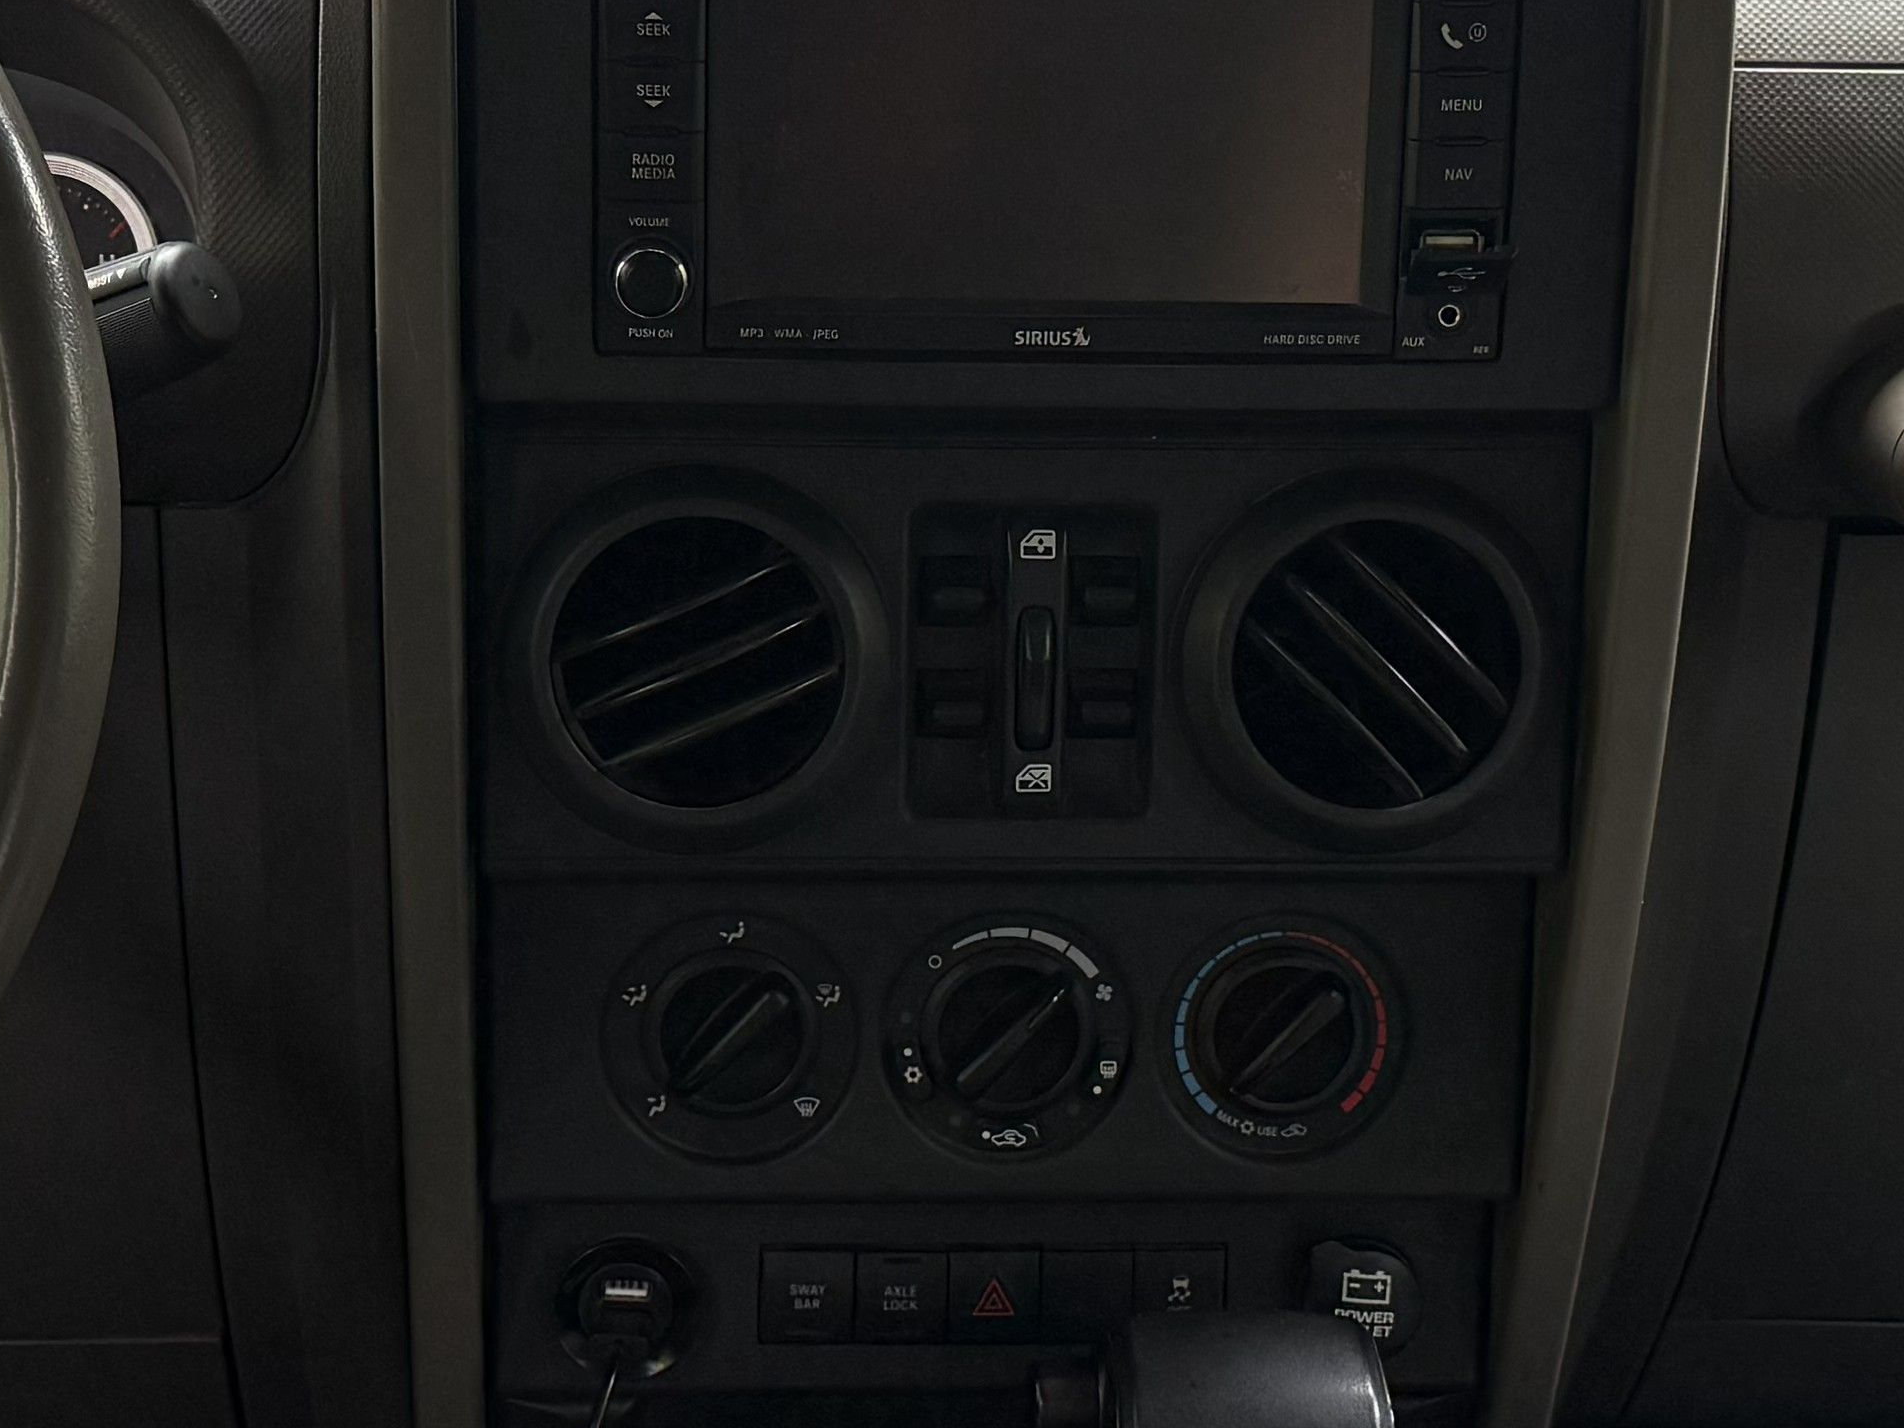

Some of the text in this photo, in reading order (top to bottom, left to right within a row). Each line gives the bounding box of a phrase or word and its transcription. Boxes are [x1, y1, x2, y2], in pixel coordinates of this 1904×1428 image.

[636, 23, 672, 36] SEEK
[636, 83, 672, 97] SEEK
[1440, 98, 1483, 112] MENU
[631, 153, 675, 166] RADIO
[631, 167, 676, 180] MEDIA
[1444, 168, 1474, 181] NAV
[628, 216, 671, 228] VOLUME
[628, 327, 674, 339] PUSH ON
[740, 328, 840, 340] MP3 WMA JPEG
[1013, 329, 1072, 347] SIRIUS
[1263, 334, 1361, 345] HARD DISC DRIVE
[1401, 336, 1426, 347] AUX
[1215, 1109, 1279, 1136] MAX USE
[789, 1284, 827, 1297] SWAY
[884, 1285, 918, 1298] AXLE
[794, 1298, 821, 1310] BAR
[883, 1299, 919, 1311] LOCK
